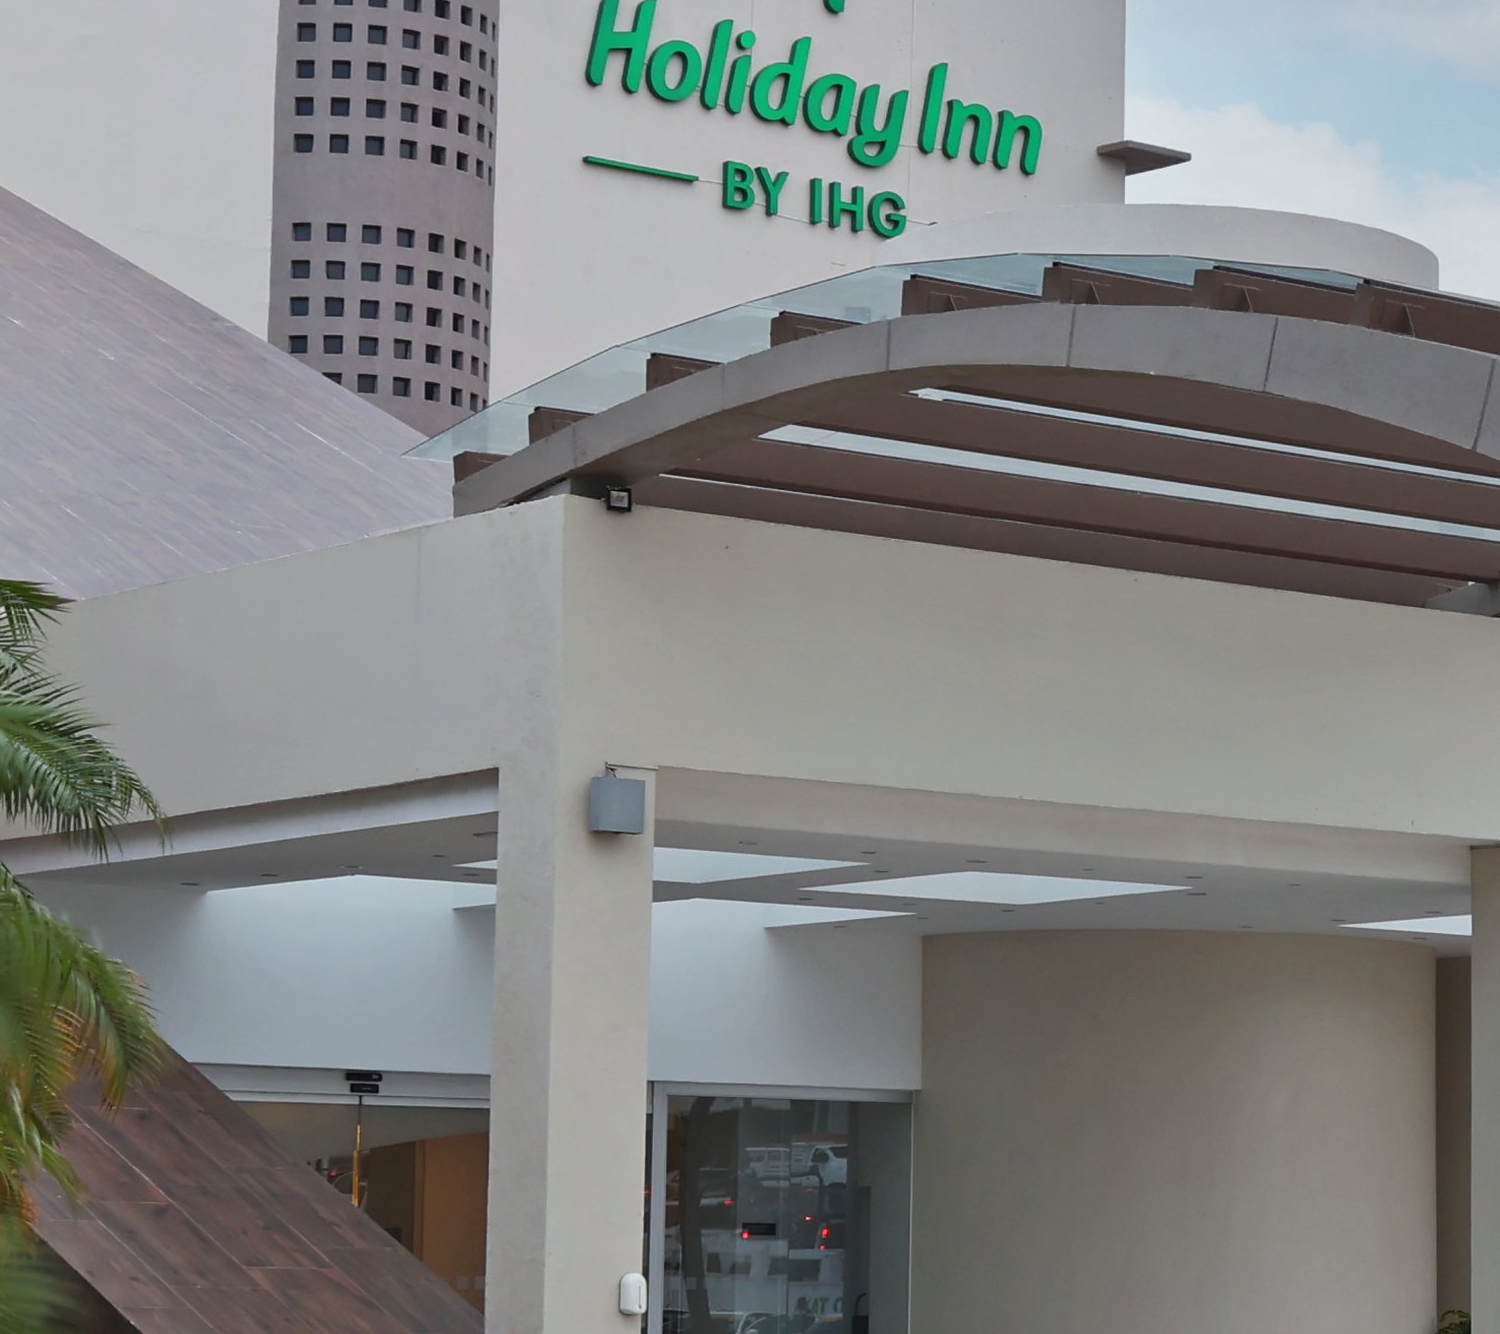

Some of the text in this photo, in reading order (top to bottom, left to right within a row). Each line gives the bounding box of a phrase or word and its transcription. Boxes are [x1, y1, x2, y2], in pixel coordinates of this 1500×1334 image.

[917, 62, 1043, 176] Inn
[722, 160, 907, 239] BY IHG
